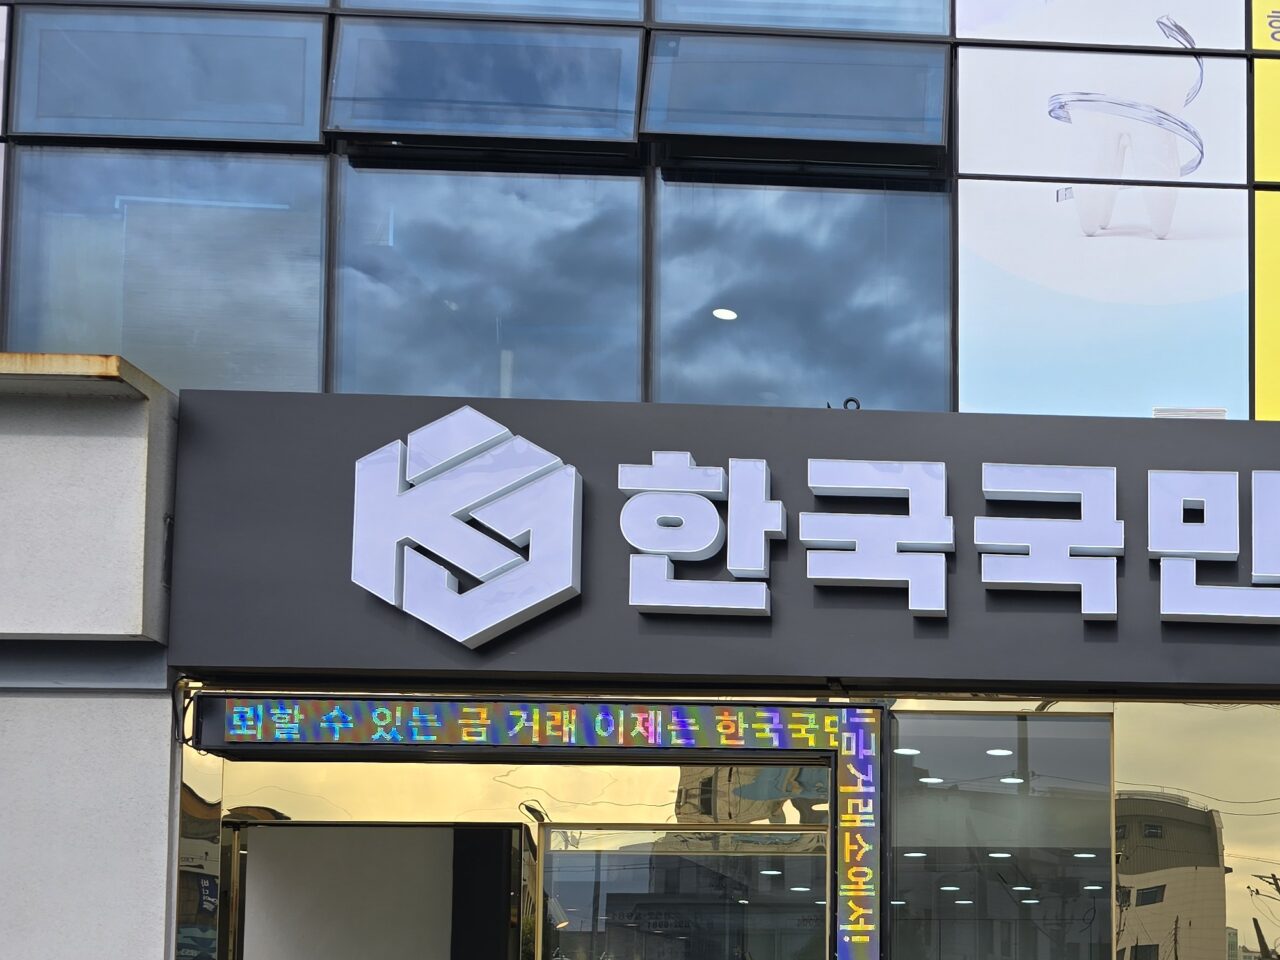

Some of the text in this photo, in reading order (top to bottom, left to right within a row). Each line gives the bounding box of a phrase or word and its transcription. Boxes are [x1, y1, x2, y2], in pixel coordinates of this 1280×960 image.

[320, 705, 354, 741] 수
[372, 706, 442, 741] 있는
[595, 709, 699, 745] 이제는
